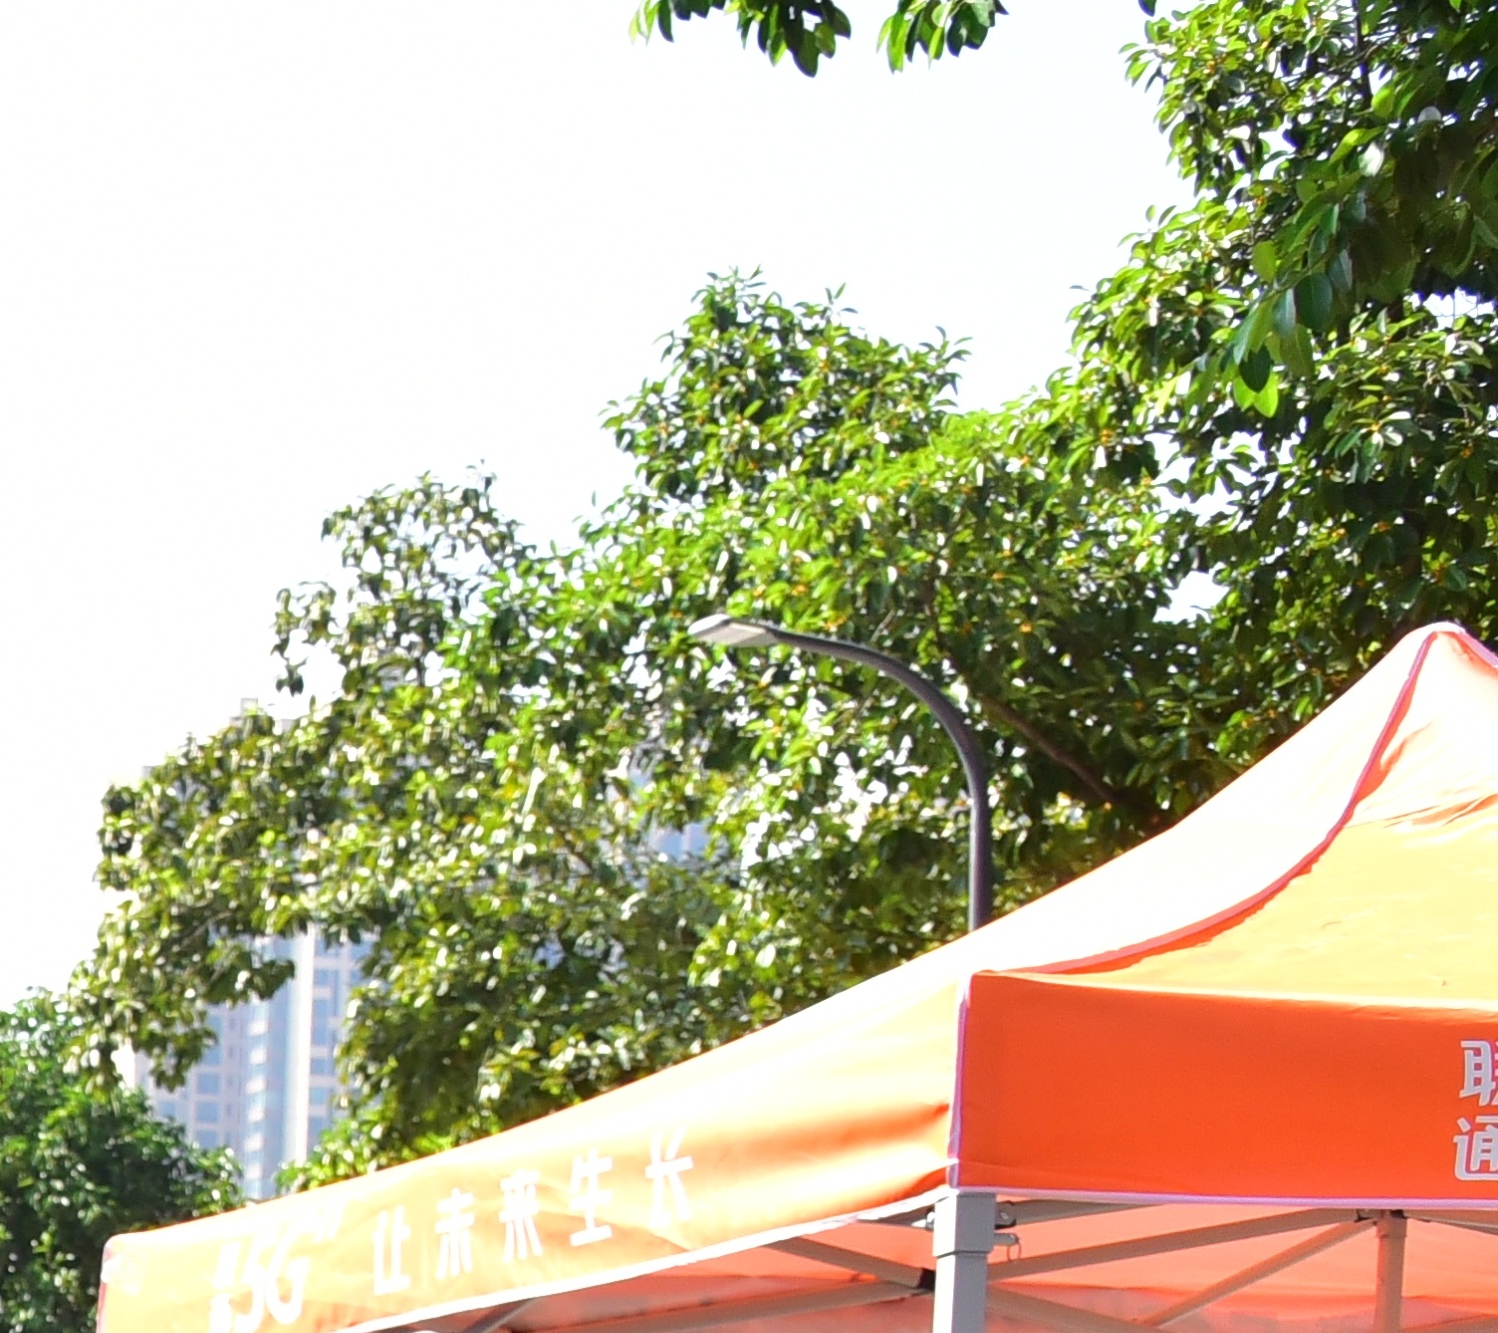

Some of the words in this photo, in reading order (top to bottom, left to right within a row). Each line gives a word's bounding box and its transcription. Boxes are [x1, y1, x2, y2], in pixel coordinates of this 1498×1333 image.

[371, 1126, 695, 1296] 让未来生长
